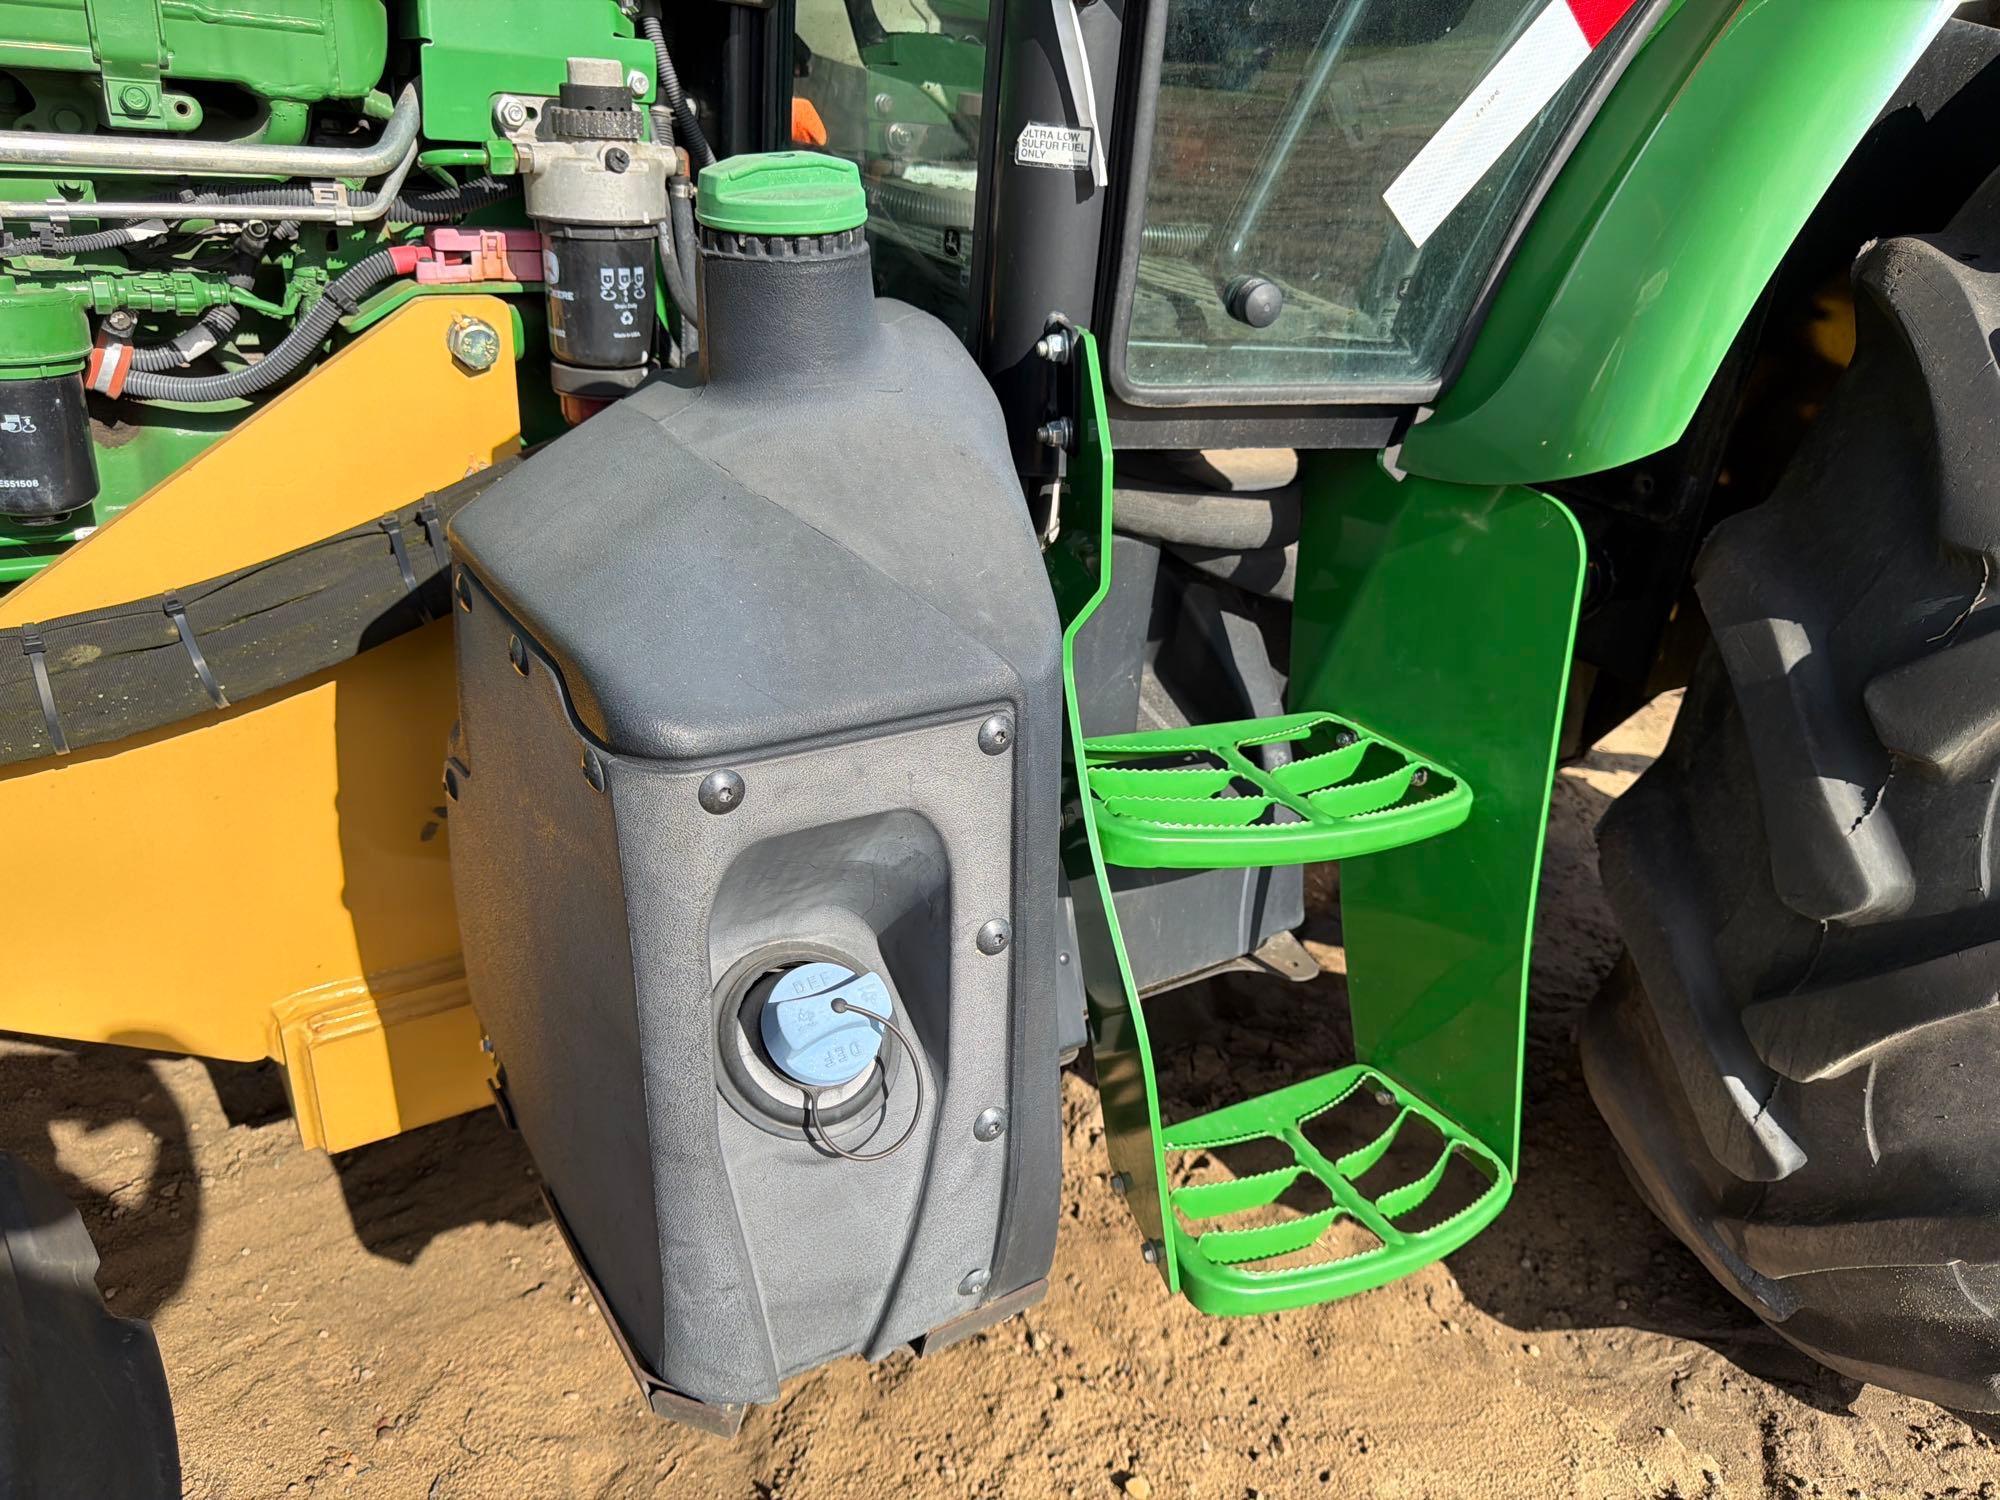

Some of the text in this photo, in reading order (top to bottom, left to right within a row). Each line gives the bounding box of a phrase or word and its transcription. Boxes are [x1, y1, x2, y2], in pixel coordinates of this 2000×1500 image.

[1057, 131, 1081, 142] LOW
[1021, 138, 1087, 153] SULFUR FUEL
[1021, 148, 1047, 159] ONLY
[792, 971, 832, 993] DEF
